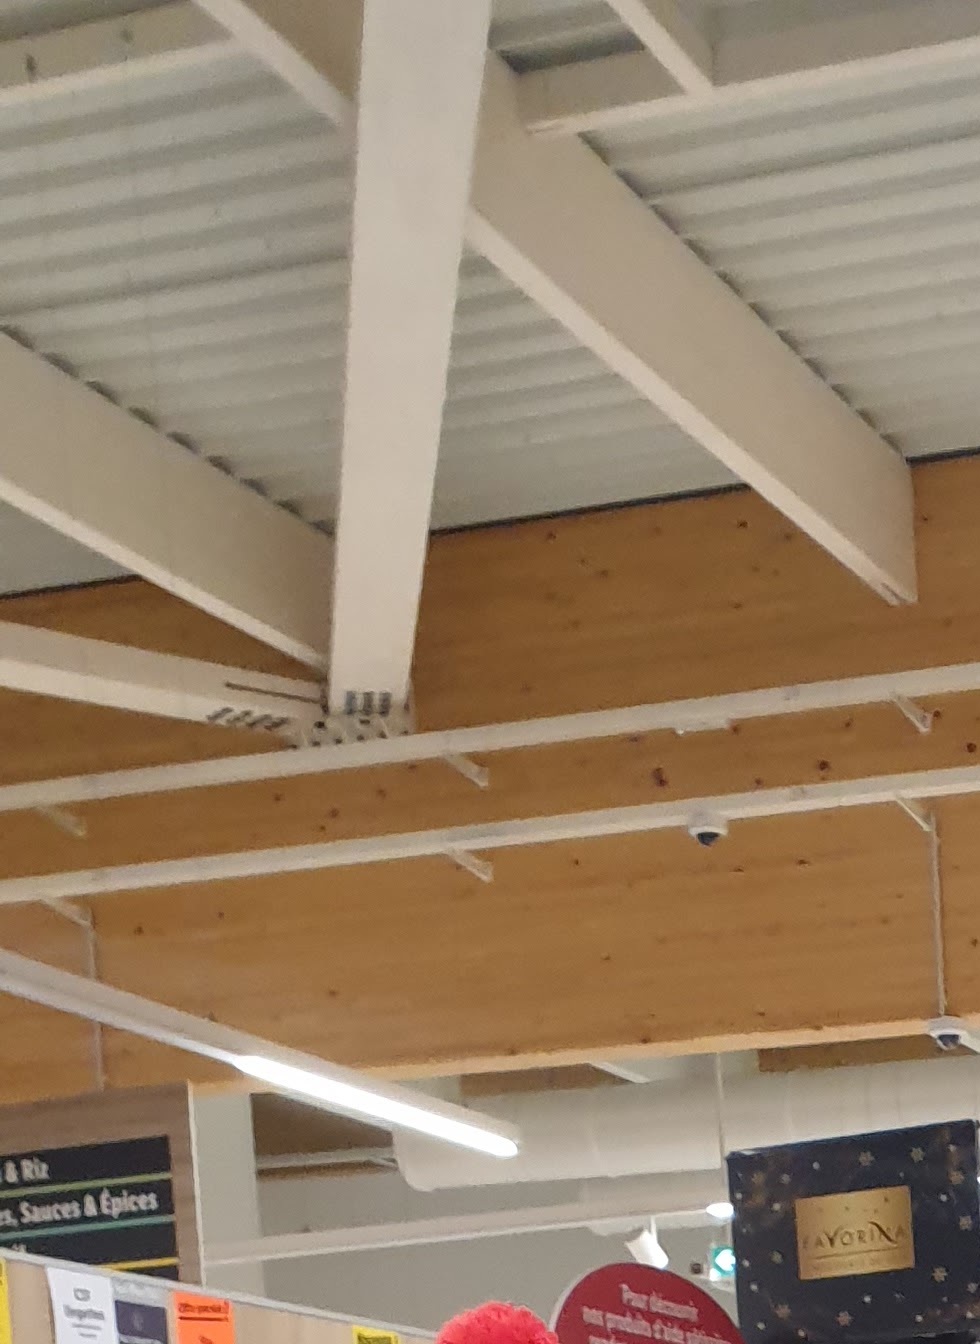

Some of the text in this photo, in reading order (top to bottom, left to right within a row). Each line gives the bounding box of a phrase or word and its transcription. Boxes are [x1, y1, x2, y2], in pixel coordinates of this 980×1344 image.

[20, 1157, 50, 1181] Riz
[19, 1200, 81, 1224] Sauces
[83, 1193, 98, 1217] &
[99, 1187, 159, 1219] Épices
